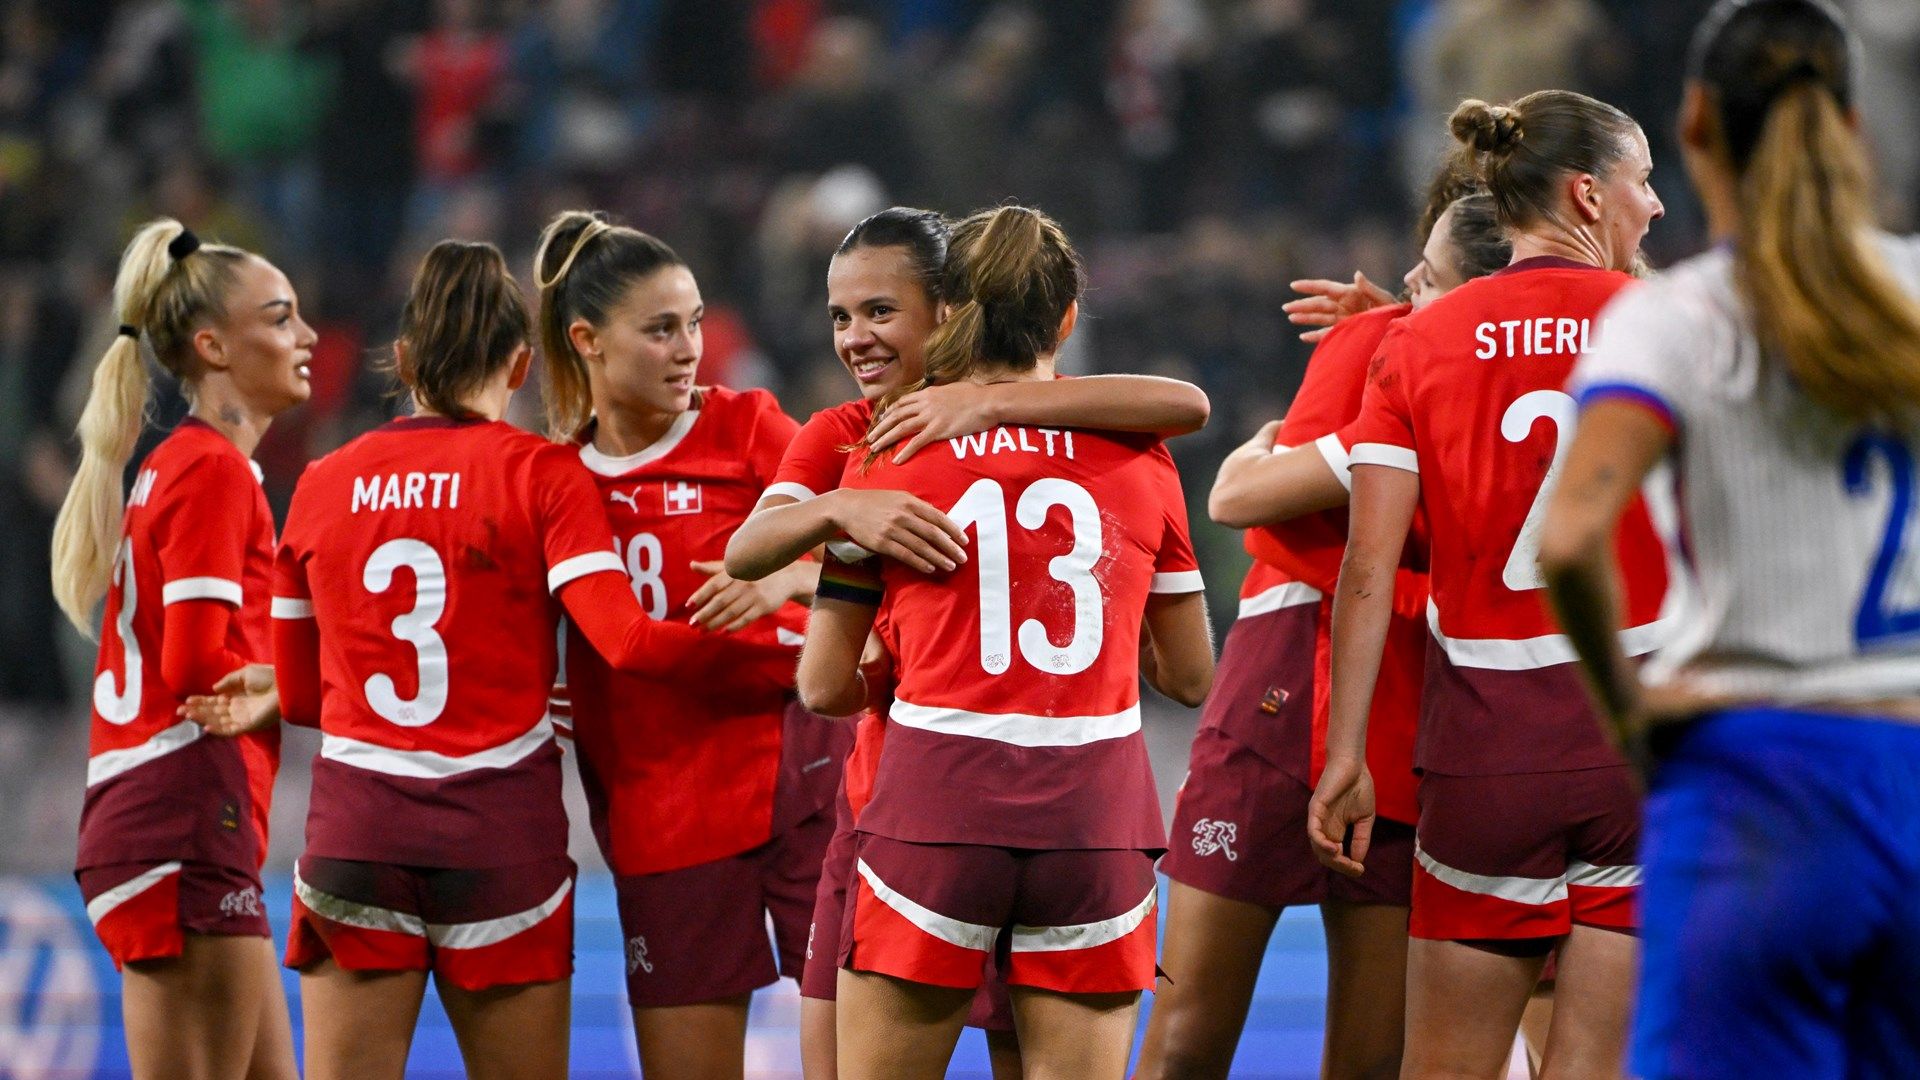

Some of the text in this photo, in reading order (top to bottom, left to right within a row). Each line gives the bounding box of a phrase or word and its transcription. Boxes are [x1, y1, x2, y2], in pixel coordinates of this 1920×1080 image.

[1475, 317, 1607, 359] STIERL
[351, 472, 460, 513] MARTI
[363, 537, 449, 728] 3
[946, 477, 1104, 675] 13
